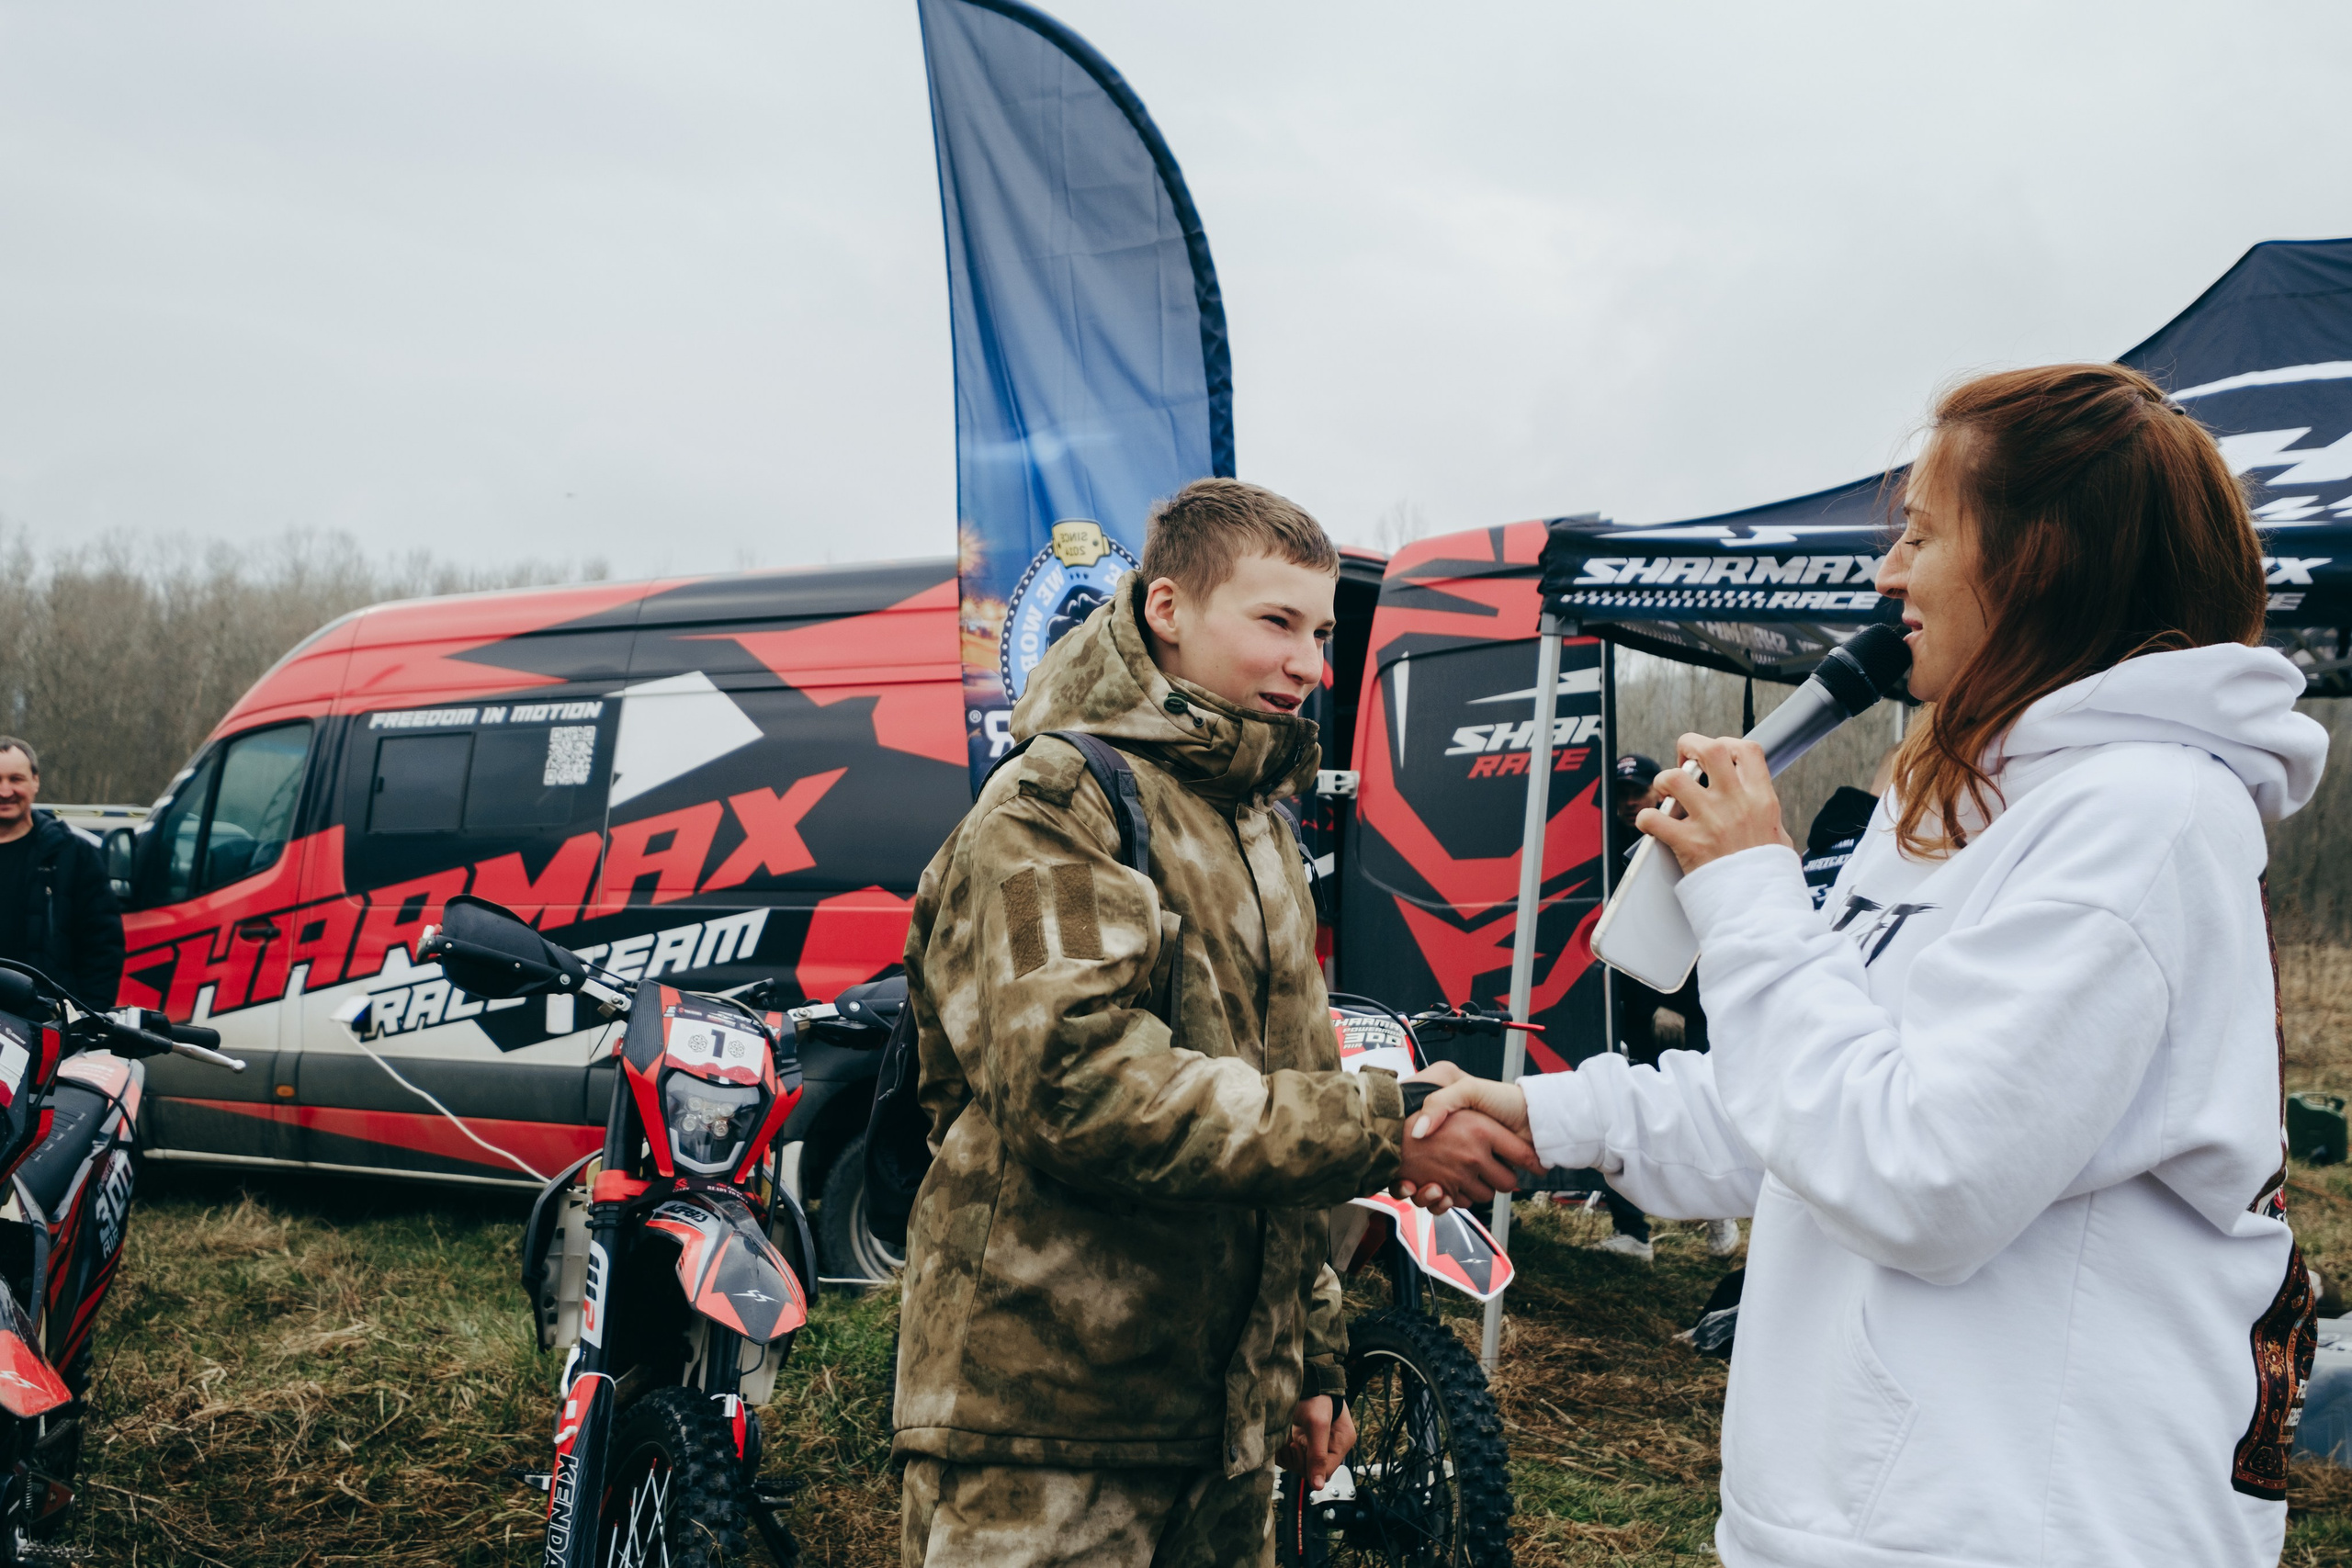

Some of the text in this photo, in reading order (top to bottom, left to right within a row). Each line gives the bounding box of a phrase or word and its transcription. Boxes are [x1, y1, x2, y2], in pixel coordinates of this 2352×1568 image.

[1574, 556, 1884, 584] SHARMAX
[1766, 591, 1883, 610] RACE
[368, 701, 604, 730] FREEDOM IN MOTION
[710, 1029, 726, 1058] 1
[1343, 1032, 1402, 1046] 300
[544, 1452, 579, 1568] KENDA
